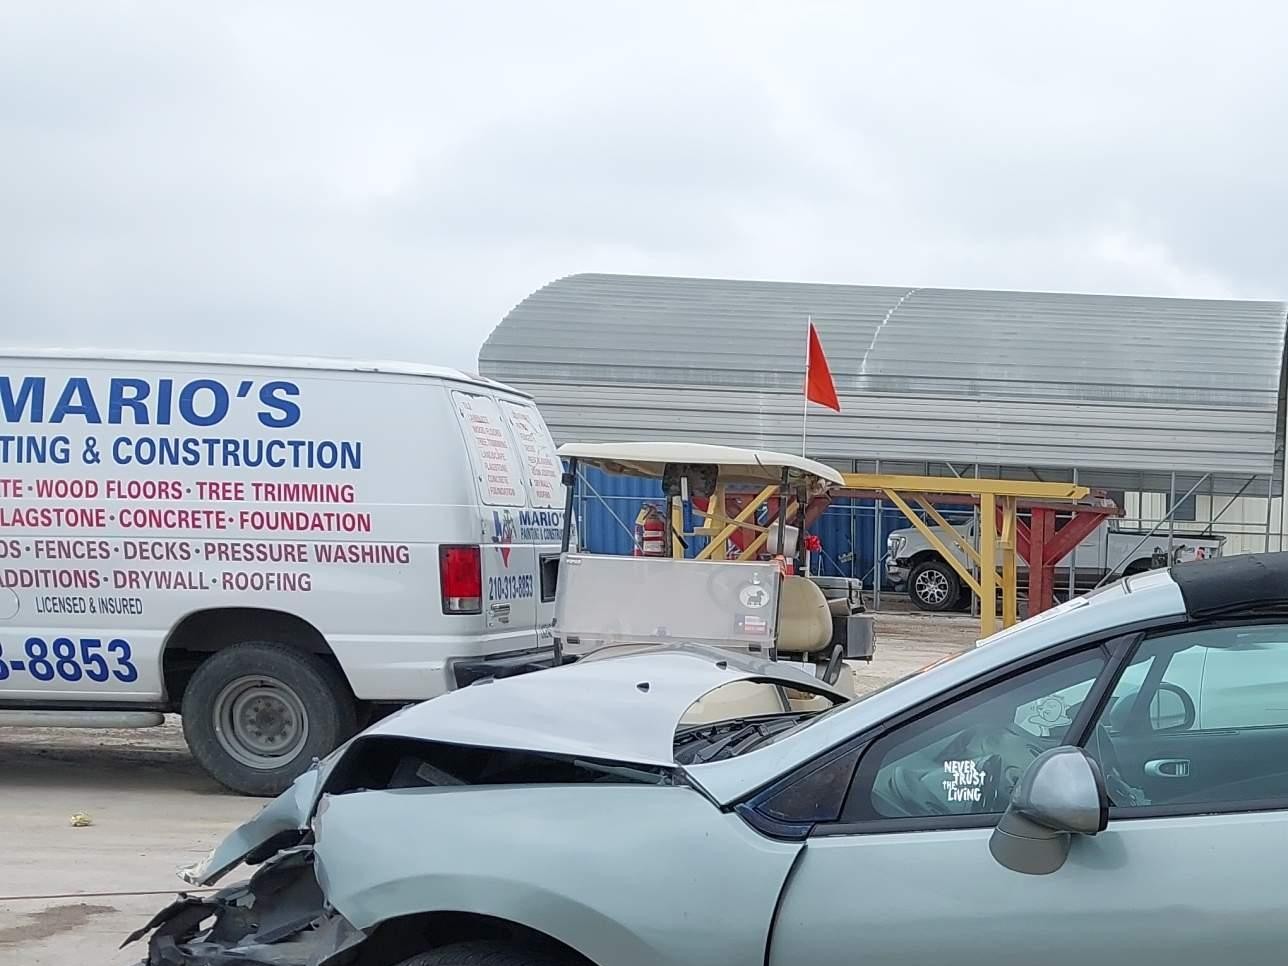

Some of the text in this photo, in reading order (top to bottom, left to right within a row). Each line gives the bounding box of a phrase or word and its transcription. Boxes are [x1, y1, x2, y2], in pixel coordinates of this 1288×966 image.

[0, 376, 301, 428] MARIO'S
[0, 435, 361, 469] TING & CONSTRUCTION
[36, 480, 98, 498] WOOD
[106, 480, 182, 500] FLOORS
[196, 482, 245, 501] TREE
[251, 483, 354, 503] TRIMMING
[119, 509, 226, 529] CONCRETE
[240, 511, 371, 532] FOUNDATION
[34, 540, 110, 559] FENCES
[123, 541, 191, 560] DECKS
[204, 543, 308, 562] PRESSURE
[314, 545, 410, 564] WASHING
[113, 570, 209, 590] DRYWALL
[223, 572, 311, 591] ROOFING
[489, 575, 533, 600] 210-313-8853
[36, 596, 142, 614] LICENSED & INSURED
[944, 760, 977, 773] NEVER
[953, 770, 986, 786] TRUST
[942, 780, 957, 791] THE
